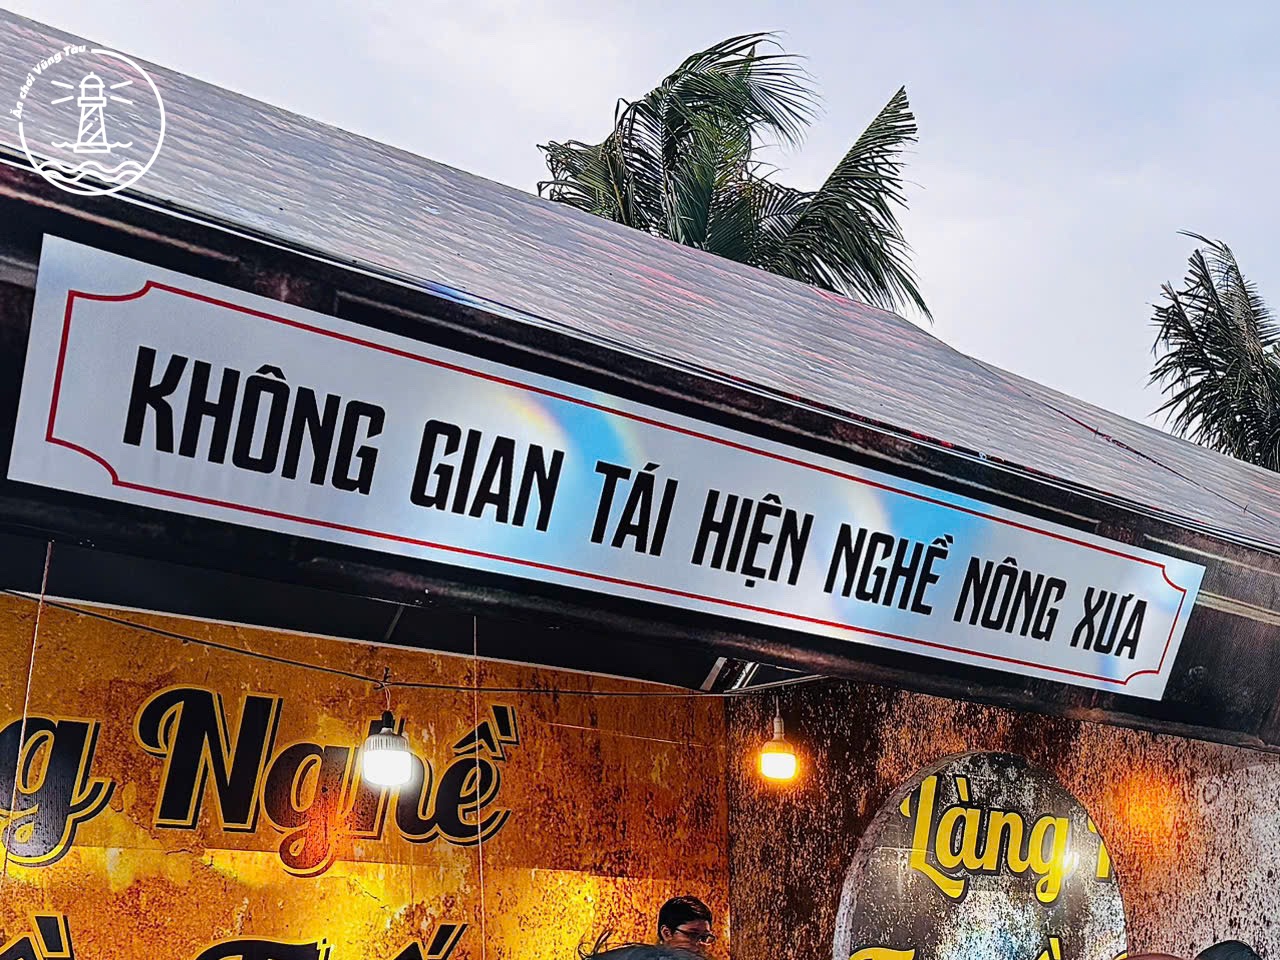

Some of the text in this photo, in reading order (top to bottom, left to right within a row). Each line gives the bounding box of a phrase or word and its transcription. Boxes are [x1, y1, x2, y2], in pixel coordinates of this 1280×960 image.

[123, 345, 386, 496] KHÔNG
[409, 418, 565, 533] GIAN
[590, 463, 678, 557] TÁI
[691, 489, 814, 588] HIỆN
[823, 522, 954, 616] NGHỀ
[953, 556, 1067, 642] NÔNG
[134, 686, 521, 878] Nghề
[900, 774, 1070, 903] Làng
